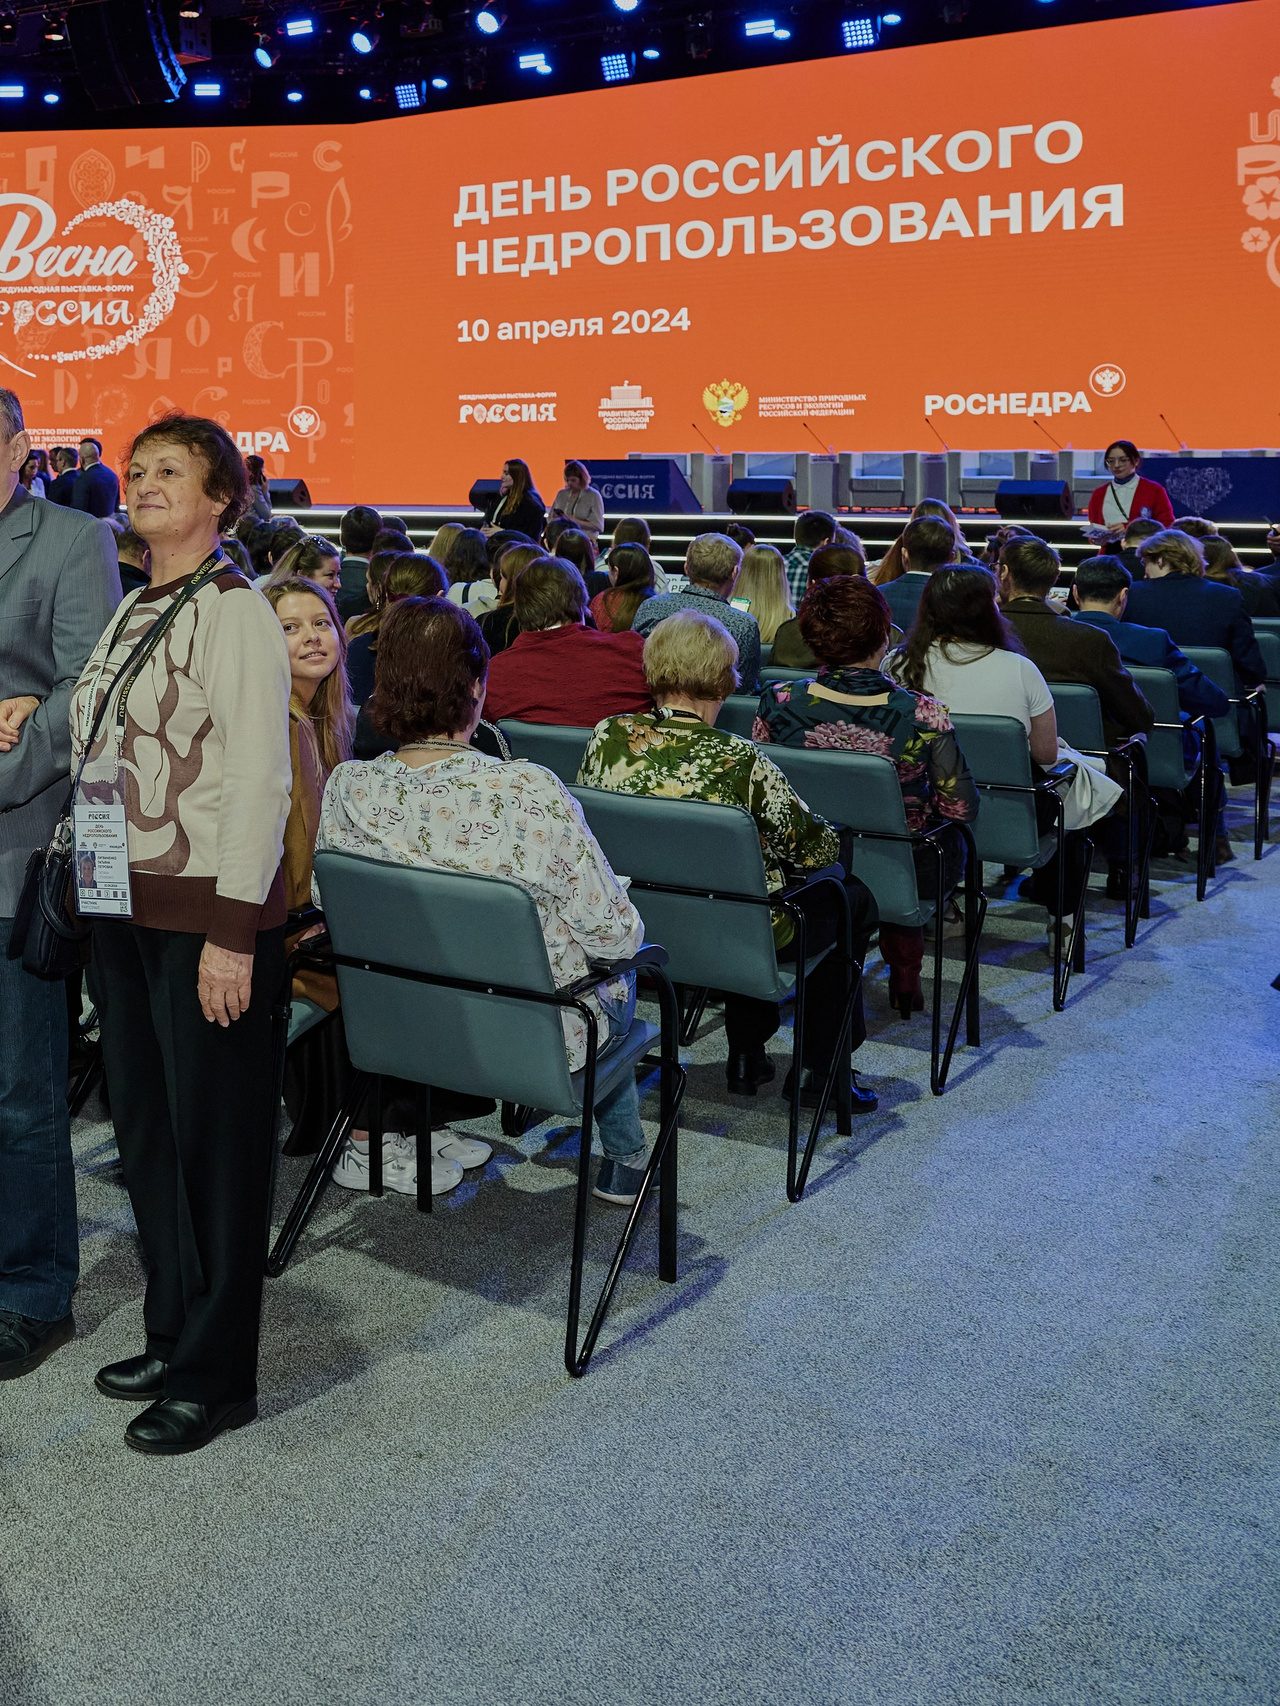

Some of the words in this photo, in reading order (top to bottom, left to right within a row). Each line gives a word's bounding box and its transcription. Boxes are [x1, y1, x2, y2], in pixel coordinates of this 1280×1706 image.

[453, 174, 592, 227] ДЕНЬ
[607, 120, 1083, 207] РОССИЙСКОГО
[454, 183, 1124, 278] НЕДРОПОЛЬЗОВАНИЯ
[61, 284, 134, 293] ВЫСТАВКА-ФОРУМ
[456, 318, 490, 343] 10
[496, 313, 604, 345] апреля
[611, 307, 691, 335] 2024
[758, 395, 818, 404] МИНИСТЕРСТВО
[818, 394, 867, 402] ПРИРОДНЫХ
[924, 391, 1093, 417] РОСНЕДРА
[458, 403, 557, 424] РОССИЯ
[598, 410, 655, 418] ПРАВИТЕЛЬСТВО
[603, 416, 650, 424] РОССИЙСКОЙ
[758, 409, 809, 418] РОССИЙСКОЙ
[809, 408, 855, 417] ФЕДЕРАЦИИ
[56, 428, 103, 436] ПРИРОДНЫХ
[606, 423, 648, 431] ФЕДЕРАЦИИ
[600, 483, 655, 499] ССИЯ
[190, 557, 217, 585] RUSSIA.RU
[119, 675, 136, 718] RUSSIA.RU
